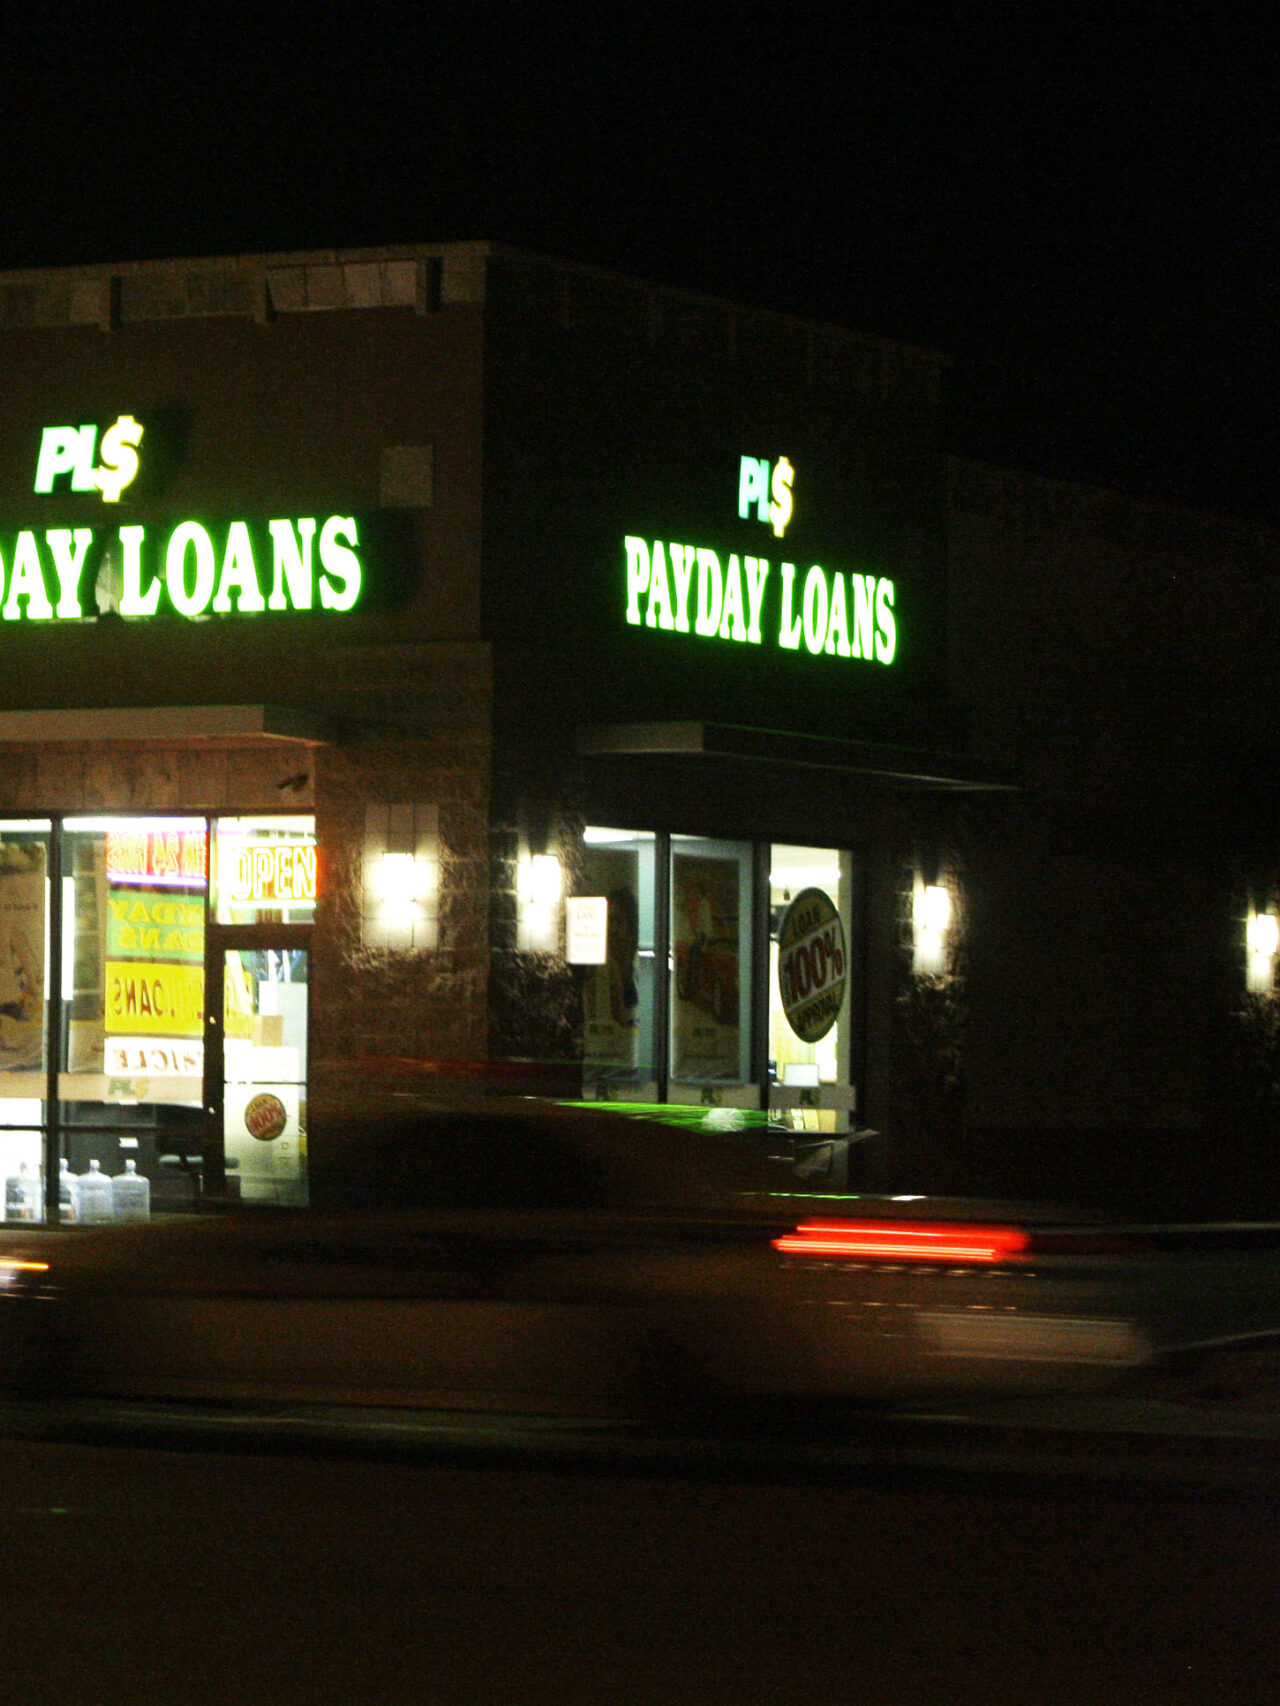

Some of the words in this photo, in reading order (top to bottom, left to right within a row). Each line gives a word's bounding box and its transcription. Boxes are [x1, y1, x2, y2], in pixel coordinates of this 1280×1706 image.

[119, 515, 361, 617] LOANS
[625, 535, 769, 644] PAYDAY
[779, 562, 896, 666] LOANS
[231, 847, 317, 899] OPEN
[783, 925, 843, 1003] 100%
